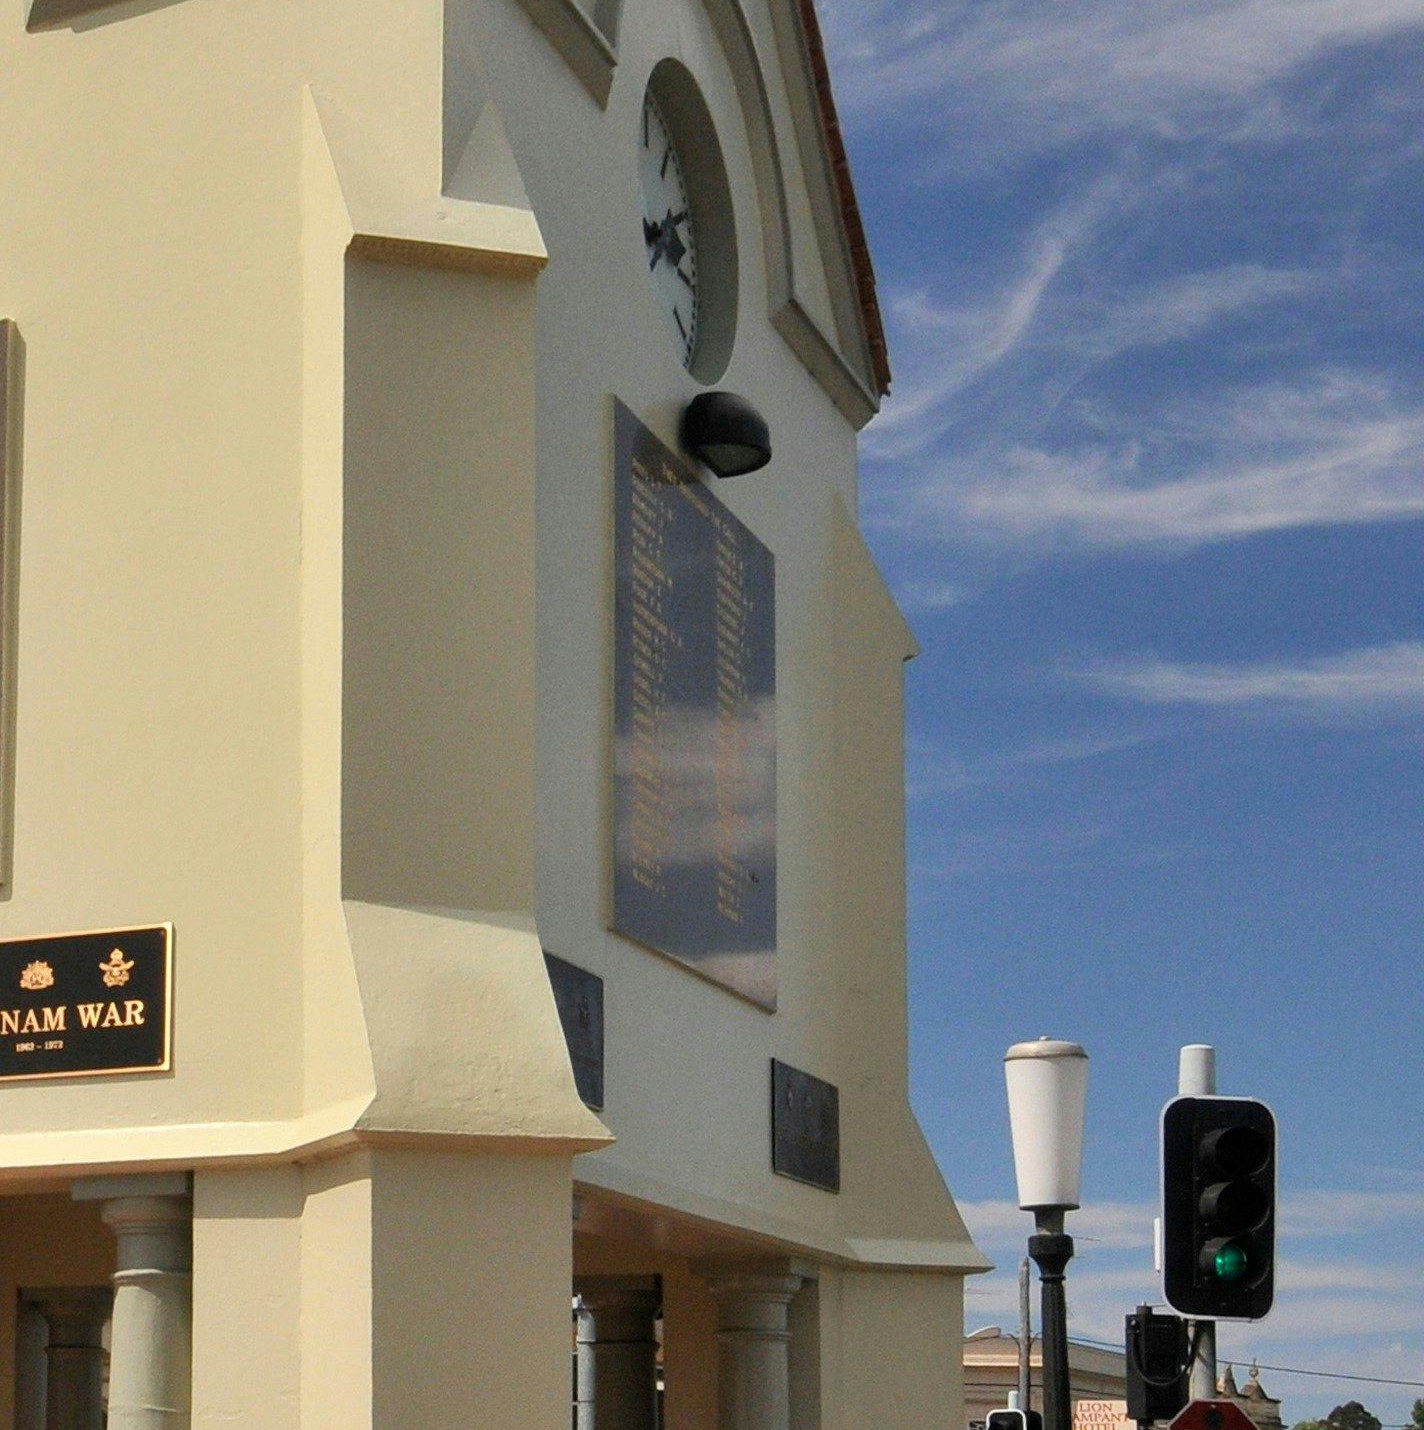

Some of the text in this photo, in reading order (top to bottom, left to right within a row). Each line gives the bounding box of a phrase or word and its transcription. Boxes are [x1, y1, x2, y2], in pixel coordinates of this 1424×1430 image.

[76, 999, 146, 1029] WAR
[1079, 1403, 1113, 1412] LION
[1073, 1413, 1129, 1422] AMPANT
